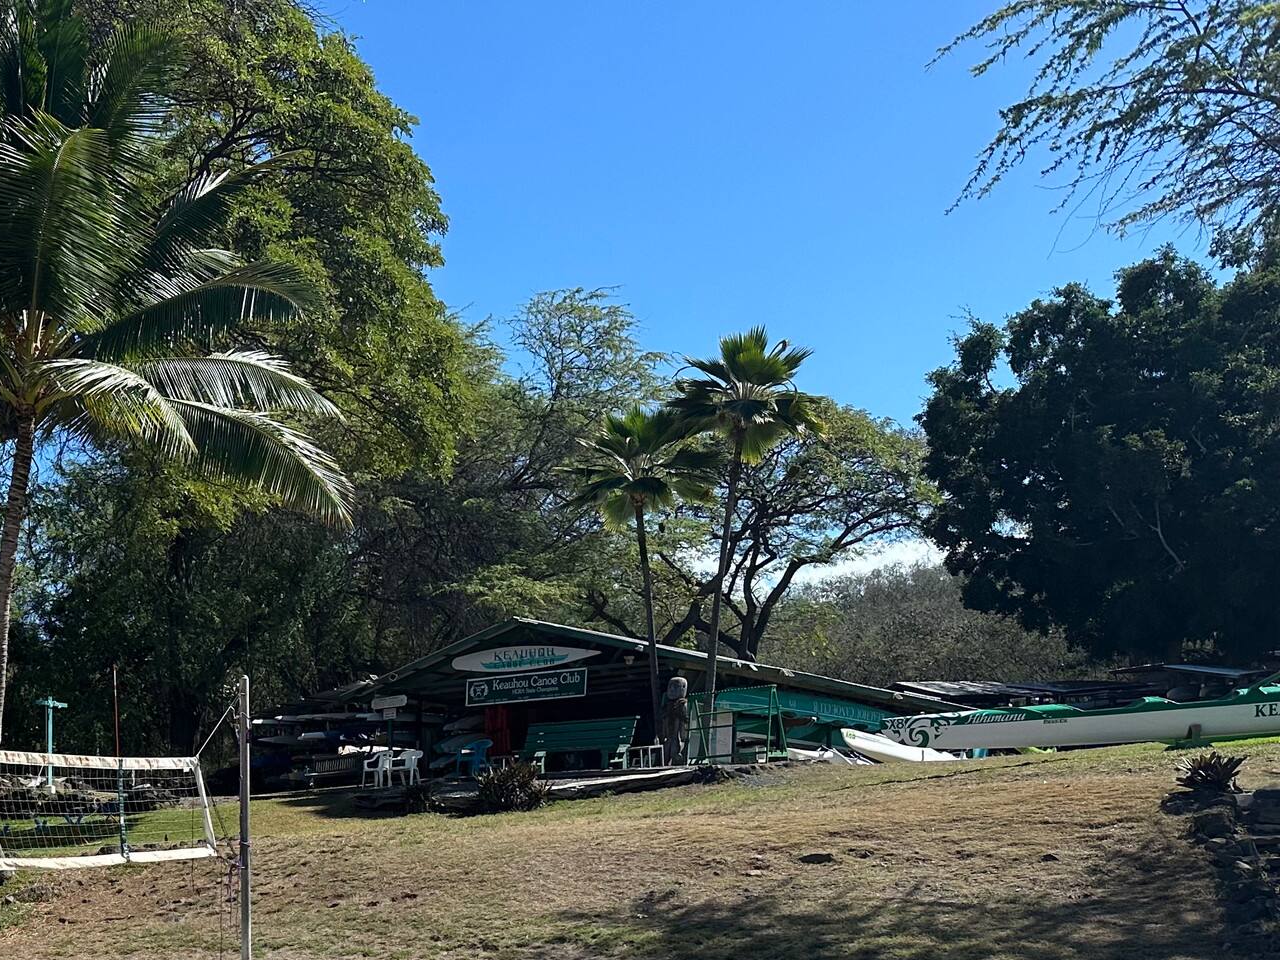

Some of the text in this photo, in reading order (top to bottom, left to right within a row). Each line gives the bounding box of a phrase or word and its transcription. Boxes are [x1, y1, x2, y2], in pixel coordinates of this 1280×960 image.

[492, 678, 529, 691] Keauhou
[530, 675, 558, 687] Canoe
[560, 672, 580, 684] Club
[1254, 703, 1280, 718] KE
[889, 718, 905, 730] X8
